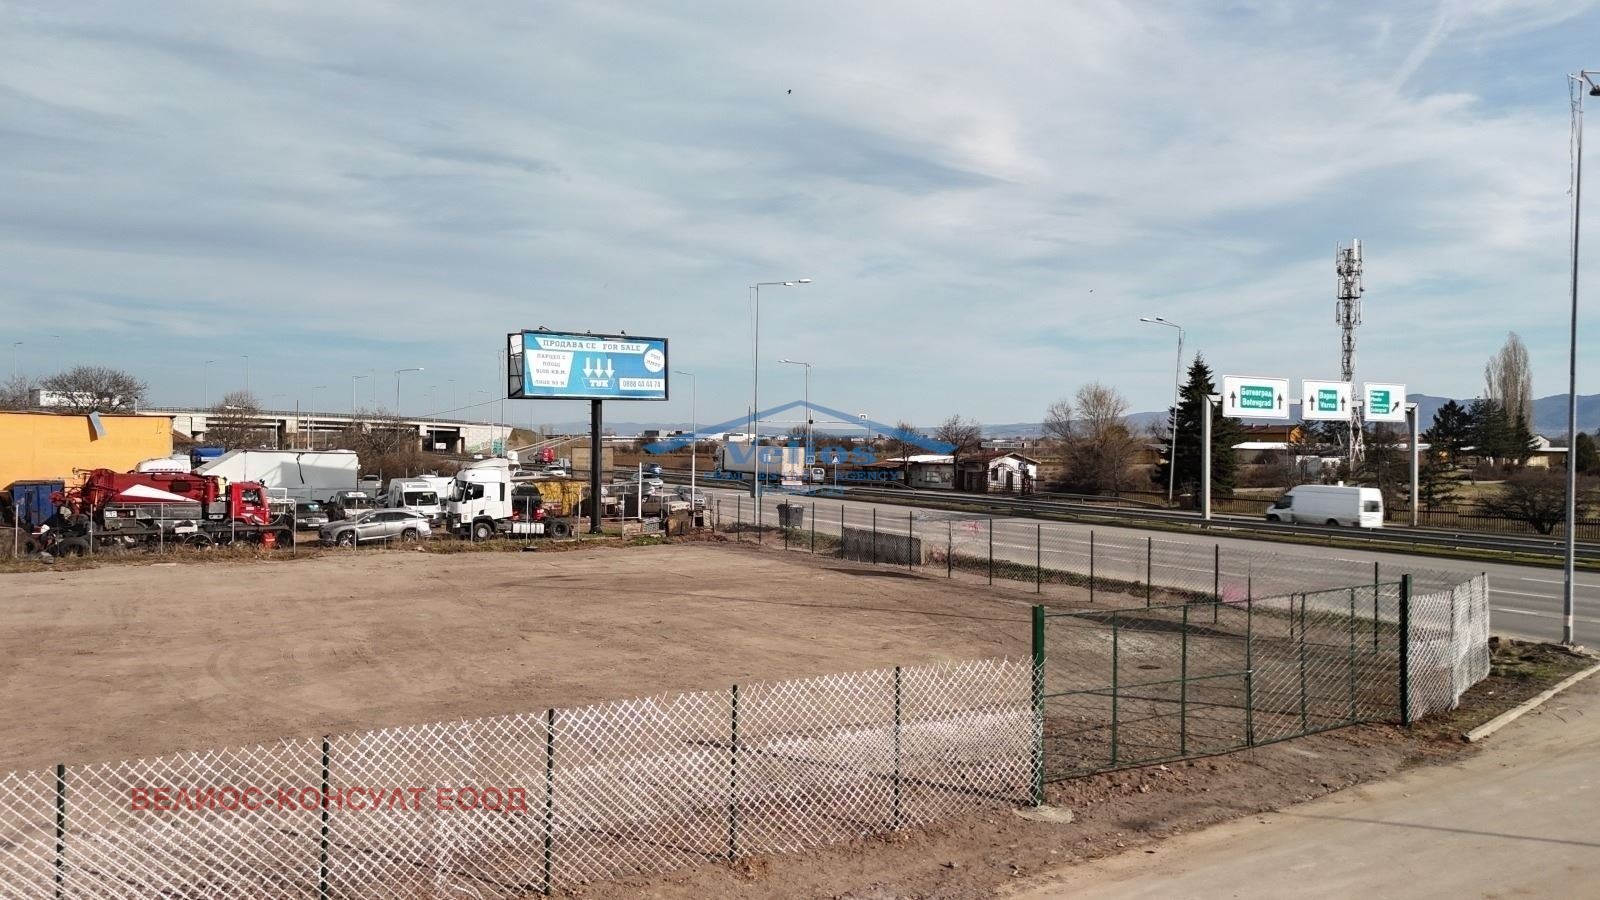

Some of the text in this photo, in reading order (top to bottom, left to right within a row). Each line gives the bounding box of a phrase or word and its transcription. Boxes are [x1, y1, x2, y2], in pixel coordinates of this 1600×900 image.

[543, 339, 583, 349] ПРОДАВА
[603, 343, 618, 351] FOR
[620, 344, 641, 352] SALE
[1241, 387, 1273, 398] Ботевград
[1319, 391, 1336, 400] Варна
[1242, 397, 1272, 408] Botevgrad
[1320, 401, 1336, 409] Varna
